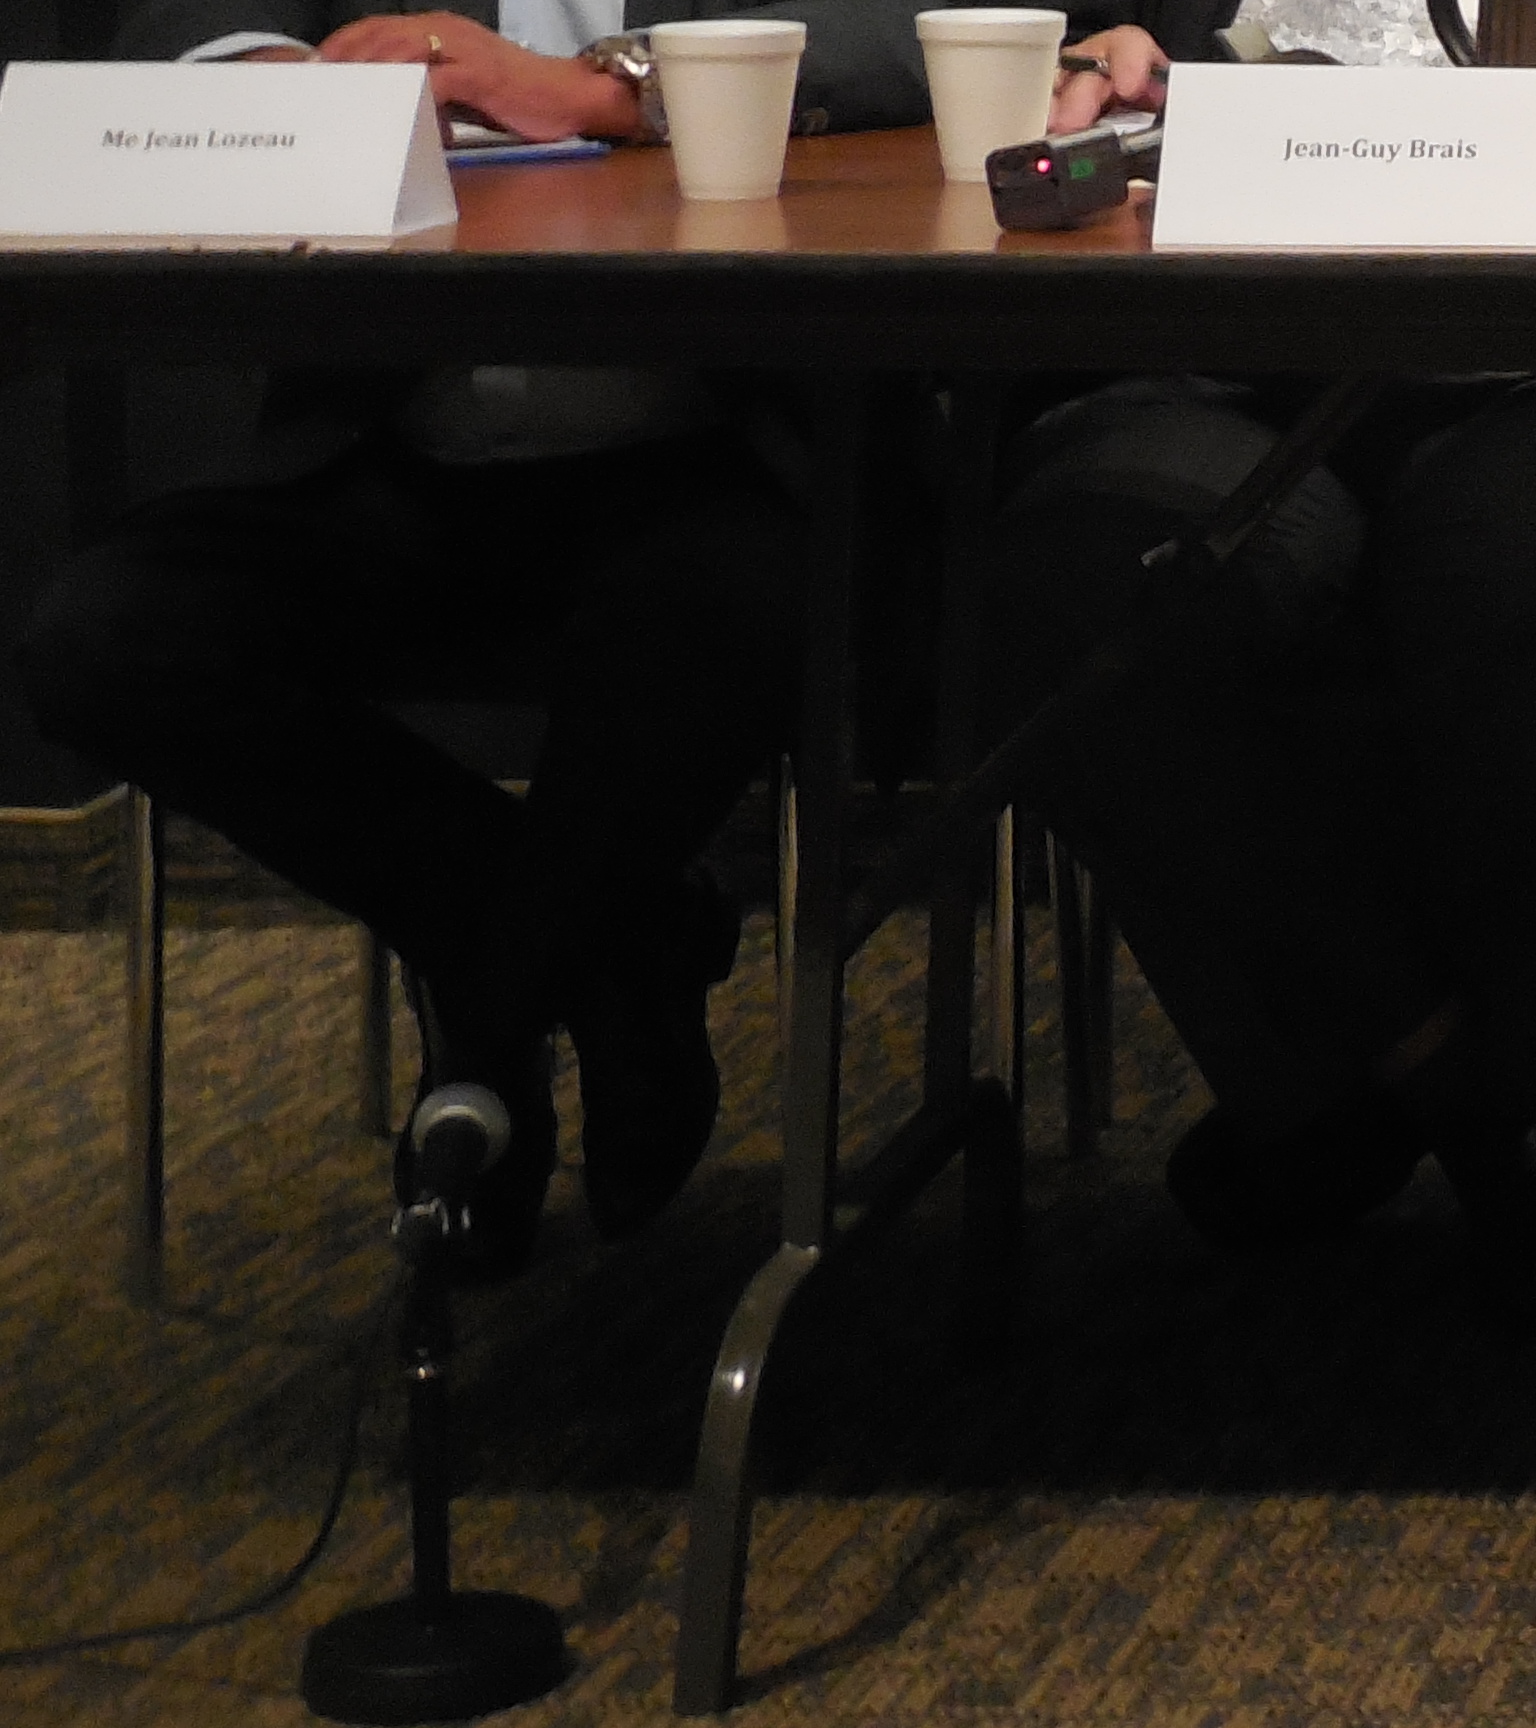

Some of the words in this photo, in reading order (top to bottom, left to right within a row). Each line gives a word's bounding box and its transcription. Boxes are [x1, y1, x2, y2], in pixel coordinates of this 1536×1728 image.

[101, 128, 138, 149] Me
[143, 129, 199, 151] Jean
[206, 129, 296, 149] Lozeau
[1283, 138, 1403, 164] Jean-Guy
[1409, 137, 1478, 160] Brais
